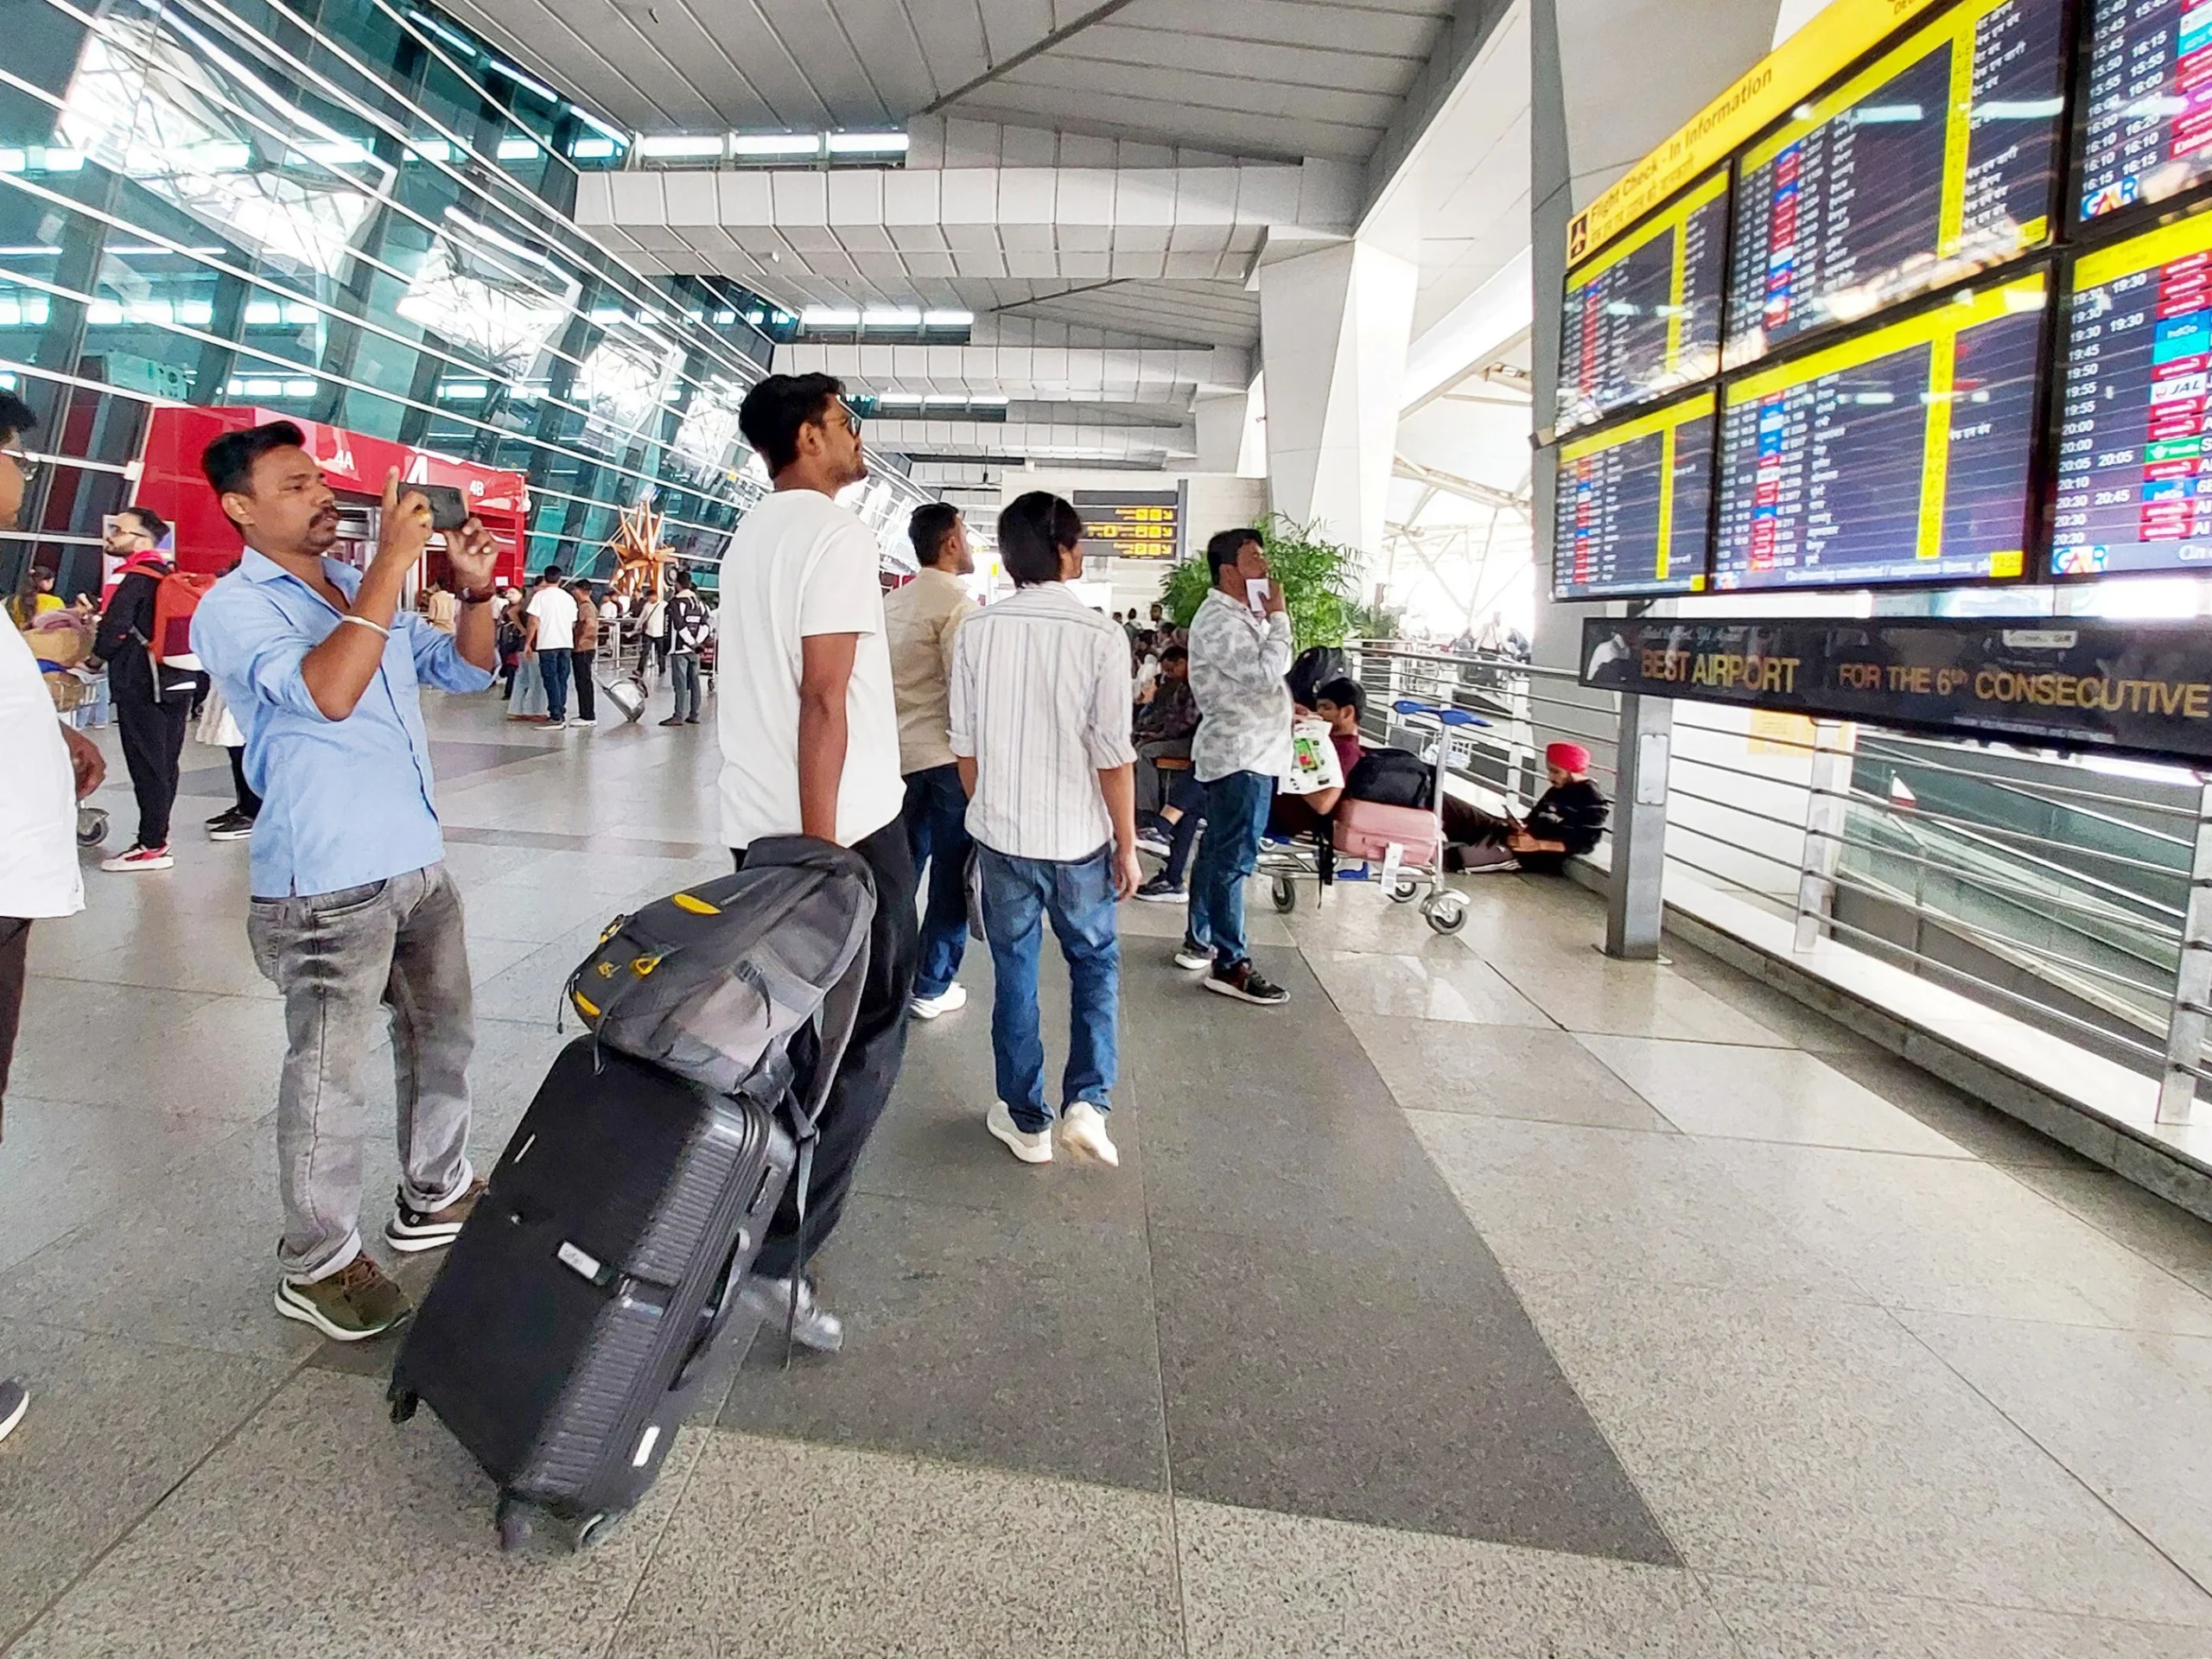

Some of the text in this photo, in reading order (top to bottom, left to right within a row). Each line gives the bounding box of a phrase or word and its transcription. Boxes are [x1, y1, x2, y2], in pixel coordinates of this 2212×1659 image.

[2094, 16, 2126, 41] 15:45
[2093, 30, 2167, 60] 15:45 16:15
[2091, 50, 2165, 79] 15:50 15:55
[2089, 71, 2164, 99] 15:55 16:00
[2088, 93, 2120, 118] 16:00
[1623, 157, 1657, 196] Check
[1685, 68, 1772, 149] Information
[2087, 113, 2160, 137] 16:00 16:20
[2085, 131, 2118, 156] 16:10
[2124, 131, 2159, 156] 16:10
[2083, 150, 2158, 175] 16:10 16:15
[2082, 170, 2114, 194] 16:15
[2112, 272, 2147, 294] 19:30
[2072, 306, 2103, 325] 19:30
[2070, 312, 2145, 344] 19:30 19:30
[2069, 344, 2101, 362] 19:45
[2067, 363, 2099, 380] 19:50
[2066, 380, 2202, 399] 19:55 JAL
[2064, 400, 2096, 417] 19:55
[2062, 419, 2094, 436] 20:00
[2060, 438, 2094, 454] 20:00
[334, 449, 355, 471] 4A
[2059, 456, 2092, 473] 20:05
[2097, 449, 2134, 467] 20:05
[468, 480, 485, 497] 4B
[2057, 475, 2090, 492] 20:10
[2056, 494, 2088, 510] 20:30
[2094, 489, 2131, 506] 20:45
[2054, 512, 2087, 528] 20:30
[2053, 521, 2210, 546] 20:30 AI
[1641, 650, 1691, 682] BEST
[1691, 653, 1801, 694] AIRPORT
[1838, 663, 1882, 690] FOR
[1886, 664, 1932, 695] THE
[1974, 671, 2212, 719] CONSECUTIVE
